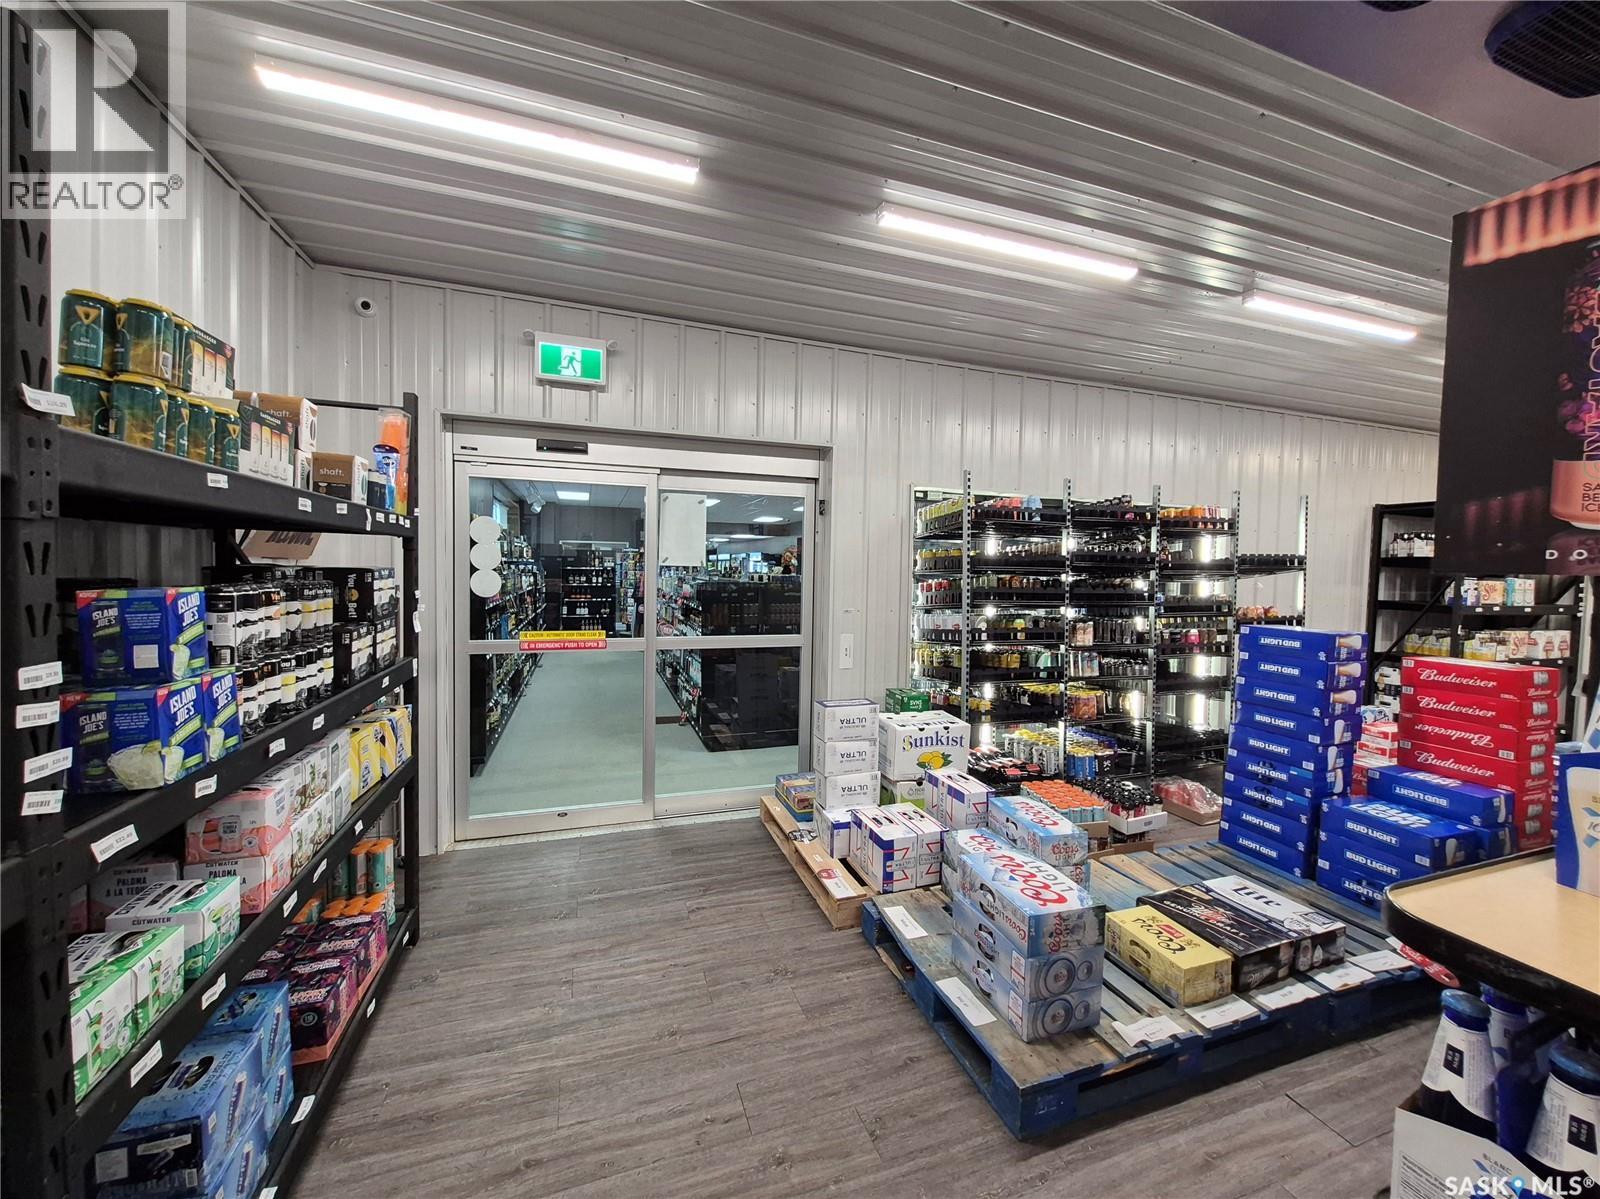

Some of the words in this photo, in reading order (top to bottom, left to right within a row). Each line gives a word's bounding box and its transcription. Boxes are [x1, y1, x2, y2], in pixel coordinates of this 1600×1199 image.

[319, 467, 345, 477] shaft.
[1581, 503, 1600, 512] IC
[1482, 583, 1498, 601] Sol
[178, 592, 200, 614] ISLAND
[92, 607, 119, 621] ISLAND
[1260, 637, 1282, 646] LIGHT
[1283, 640, 1300, 648] BUD
[1259, 663, 1281, 673] LIGHT
[1281, 667, 1299, 675] BUD
[1417, 668, 1497, 688] Budweiser
[212, 674, 233, 699] ISLAND
[1255, 688, 1277, 699] LIGHT
[170, 685, 197, 714] ISLAND
[1277, 693, 1295, 702] BUD
[1416, 695, 1496, 718] Budweiser
[79, 711, 107, 726] ISLAND
[839, 717, 867, 725] ULTRA
[1255, 714, 1271, 723] BUD
[1271, 718, 1296, 729] LIGHT
[902, 731, 965, 752] Sunkist
[1414, 723, 1495, 748] Budweiser
[1249, 739, 1265, 748] BUD
[1265, 743, 1289, 755] LIGHT
[840, 750, 867, 759] ULTRA
[1247, 763, 1269, 776] LIGHT
[1414, 750, 1495, 777] Budweiser
[1269, 770, 1287, 780] BUD
[840, 784, 868, 793] ULTRA
[1244, 788, 1265, 801] LIGHT
[1394, 786, 1421, 800] LIGHT
[1265, 796, 1283, 806] BUD
[1422, 793, 1448, 806] BUD
[1241, 813, 1263, 827] LIGHT
[1263, 821, 1281, 832] BUD
[1346, 821, 1367, 834] BUD
[1368, 828, 1398, 845] LIGHT
[1051, 841, 1079, 855] Coors
[1238, 837, 1260, 851] LIGHT
[1260, 846, 1277, 858] BUD
[205, 860, 239, 868] CUTWATER
[1345, 851, 1366, 865] BUD
[1367, 859, 1399, 876] LIGHT
[208, 869, 237, 878] PALOMA
[1023, 858, 1074, 893] LIGHT
[117, 876, 148, 887] PALOMA
[992, 854, 1068, 908] Coors
[1344, 880, 1373, 896] LIGHT
[114, 888, 123, 897] LA
[1232, 886, 1282, 907] Lite
[986, 900, 1005, 922] LIGHT
[132, 917, 172, 926] CUTWATER
[1005, 915, 1027, 944] Coors
[1049, 912, 1064, 954] Coors
[1131, 918, 1186, 955] Coors
